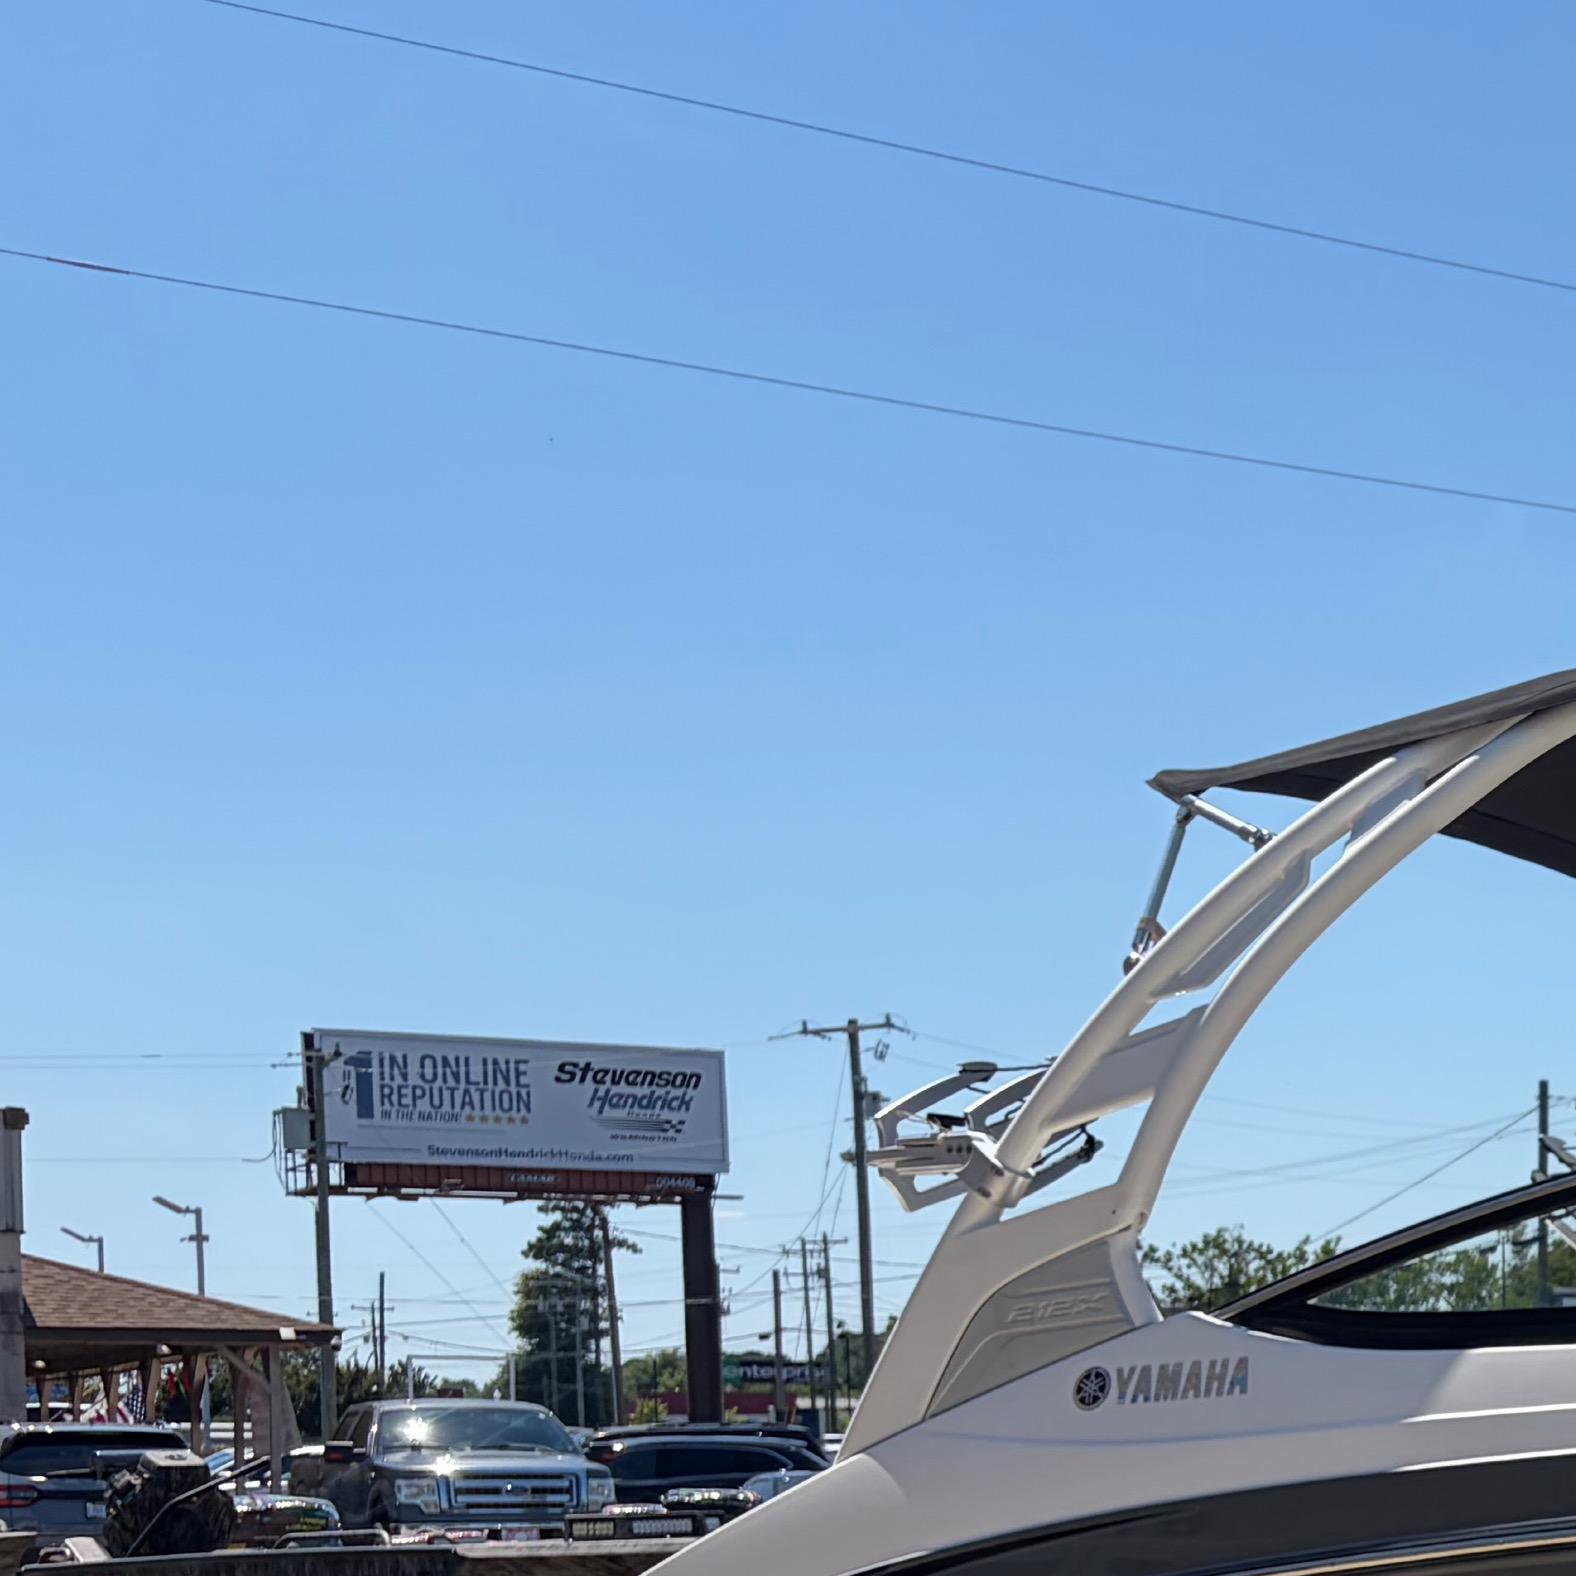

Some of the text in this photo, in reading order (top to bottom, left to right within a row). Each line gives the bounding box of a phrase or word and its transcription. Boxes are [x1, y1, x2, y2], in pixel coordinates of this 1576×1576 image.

[379, 1053, 531, 1089] IN ONLINE
[554, 1061, 702, 1090] Stevenson
[380, 1084, 532, 1114] REPUTATION
[587, 1087, 695, 1117] Hendrick
[381, 1109, 392, 1121] IN
[396, 1109, 415, 1122] THE
[1116, 1356, 1249, 1405] YAMAHA
